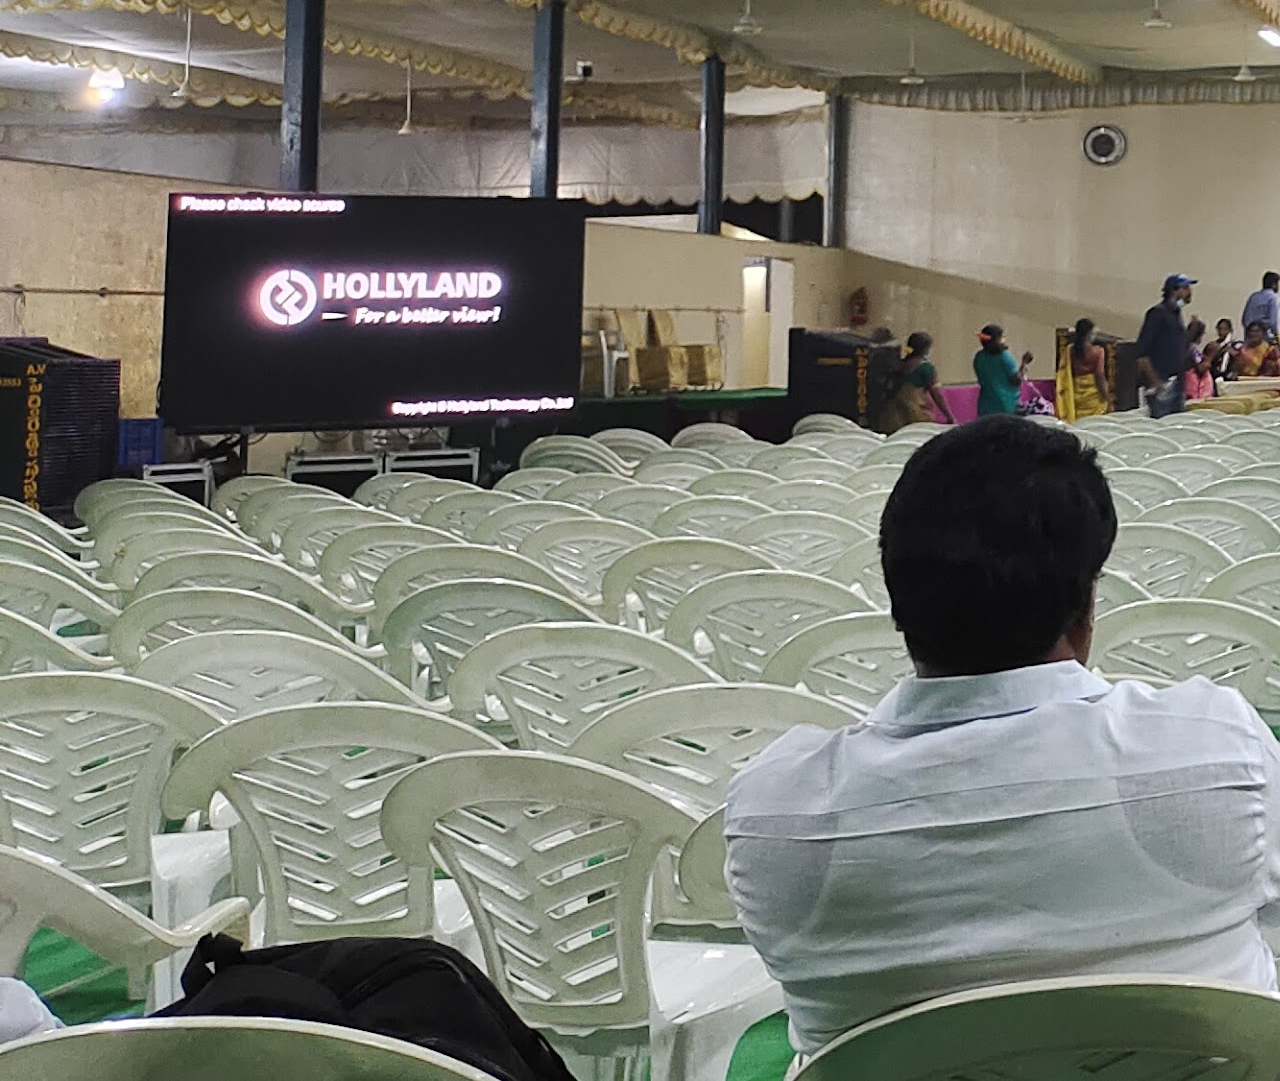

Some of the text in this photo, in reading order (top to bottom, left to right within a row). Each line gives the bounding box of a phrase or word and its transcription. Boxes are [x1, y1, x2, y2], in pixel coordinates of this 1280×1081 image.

[180, 195, 226, 211] Please
[266, 197, 302, 212] video
[323, 272, 502, 299] HOLLYLAND
[354, 306, 385, 324] For
[401, 306, 450, 324] better
[452, 306, 501, 323] view!
